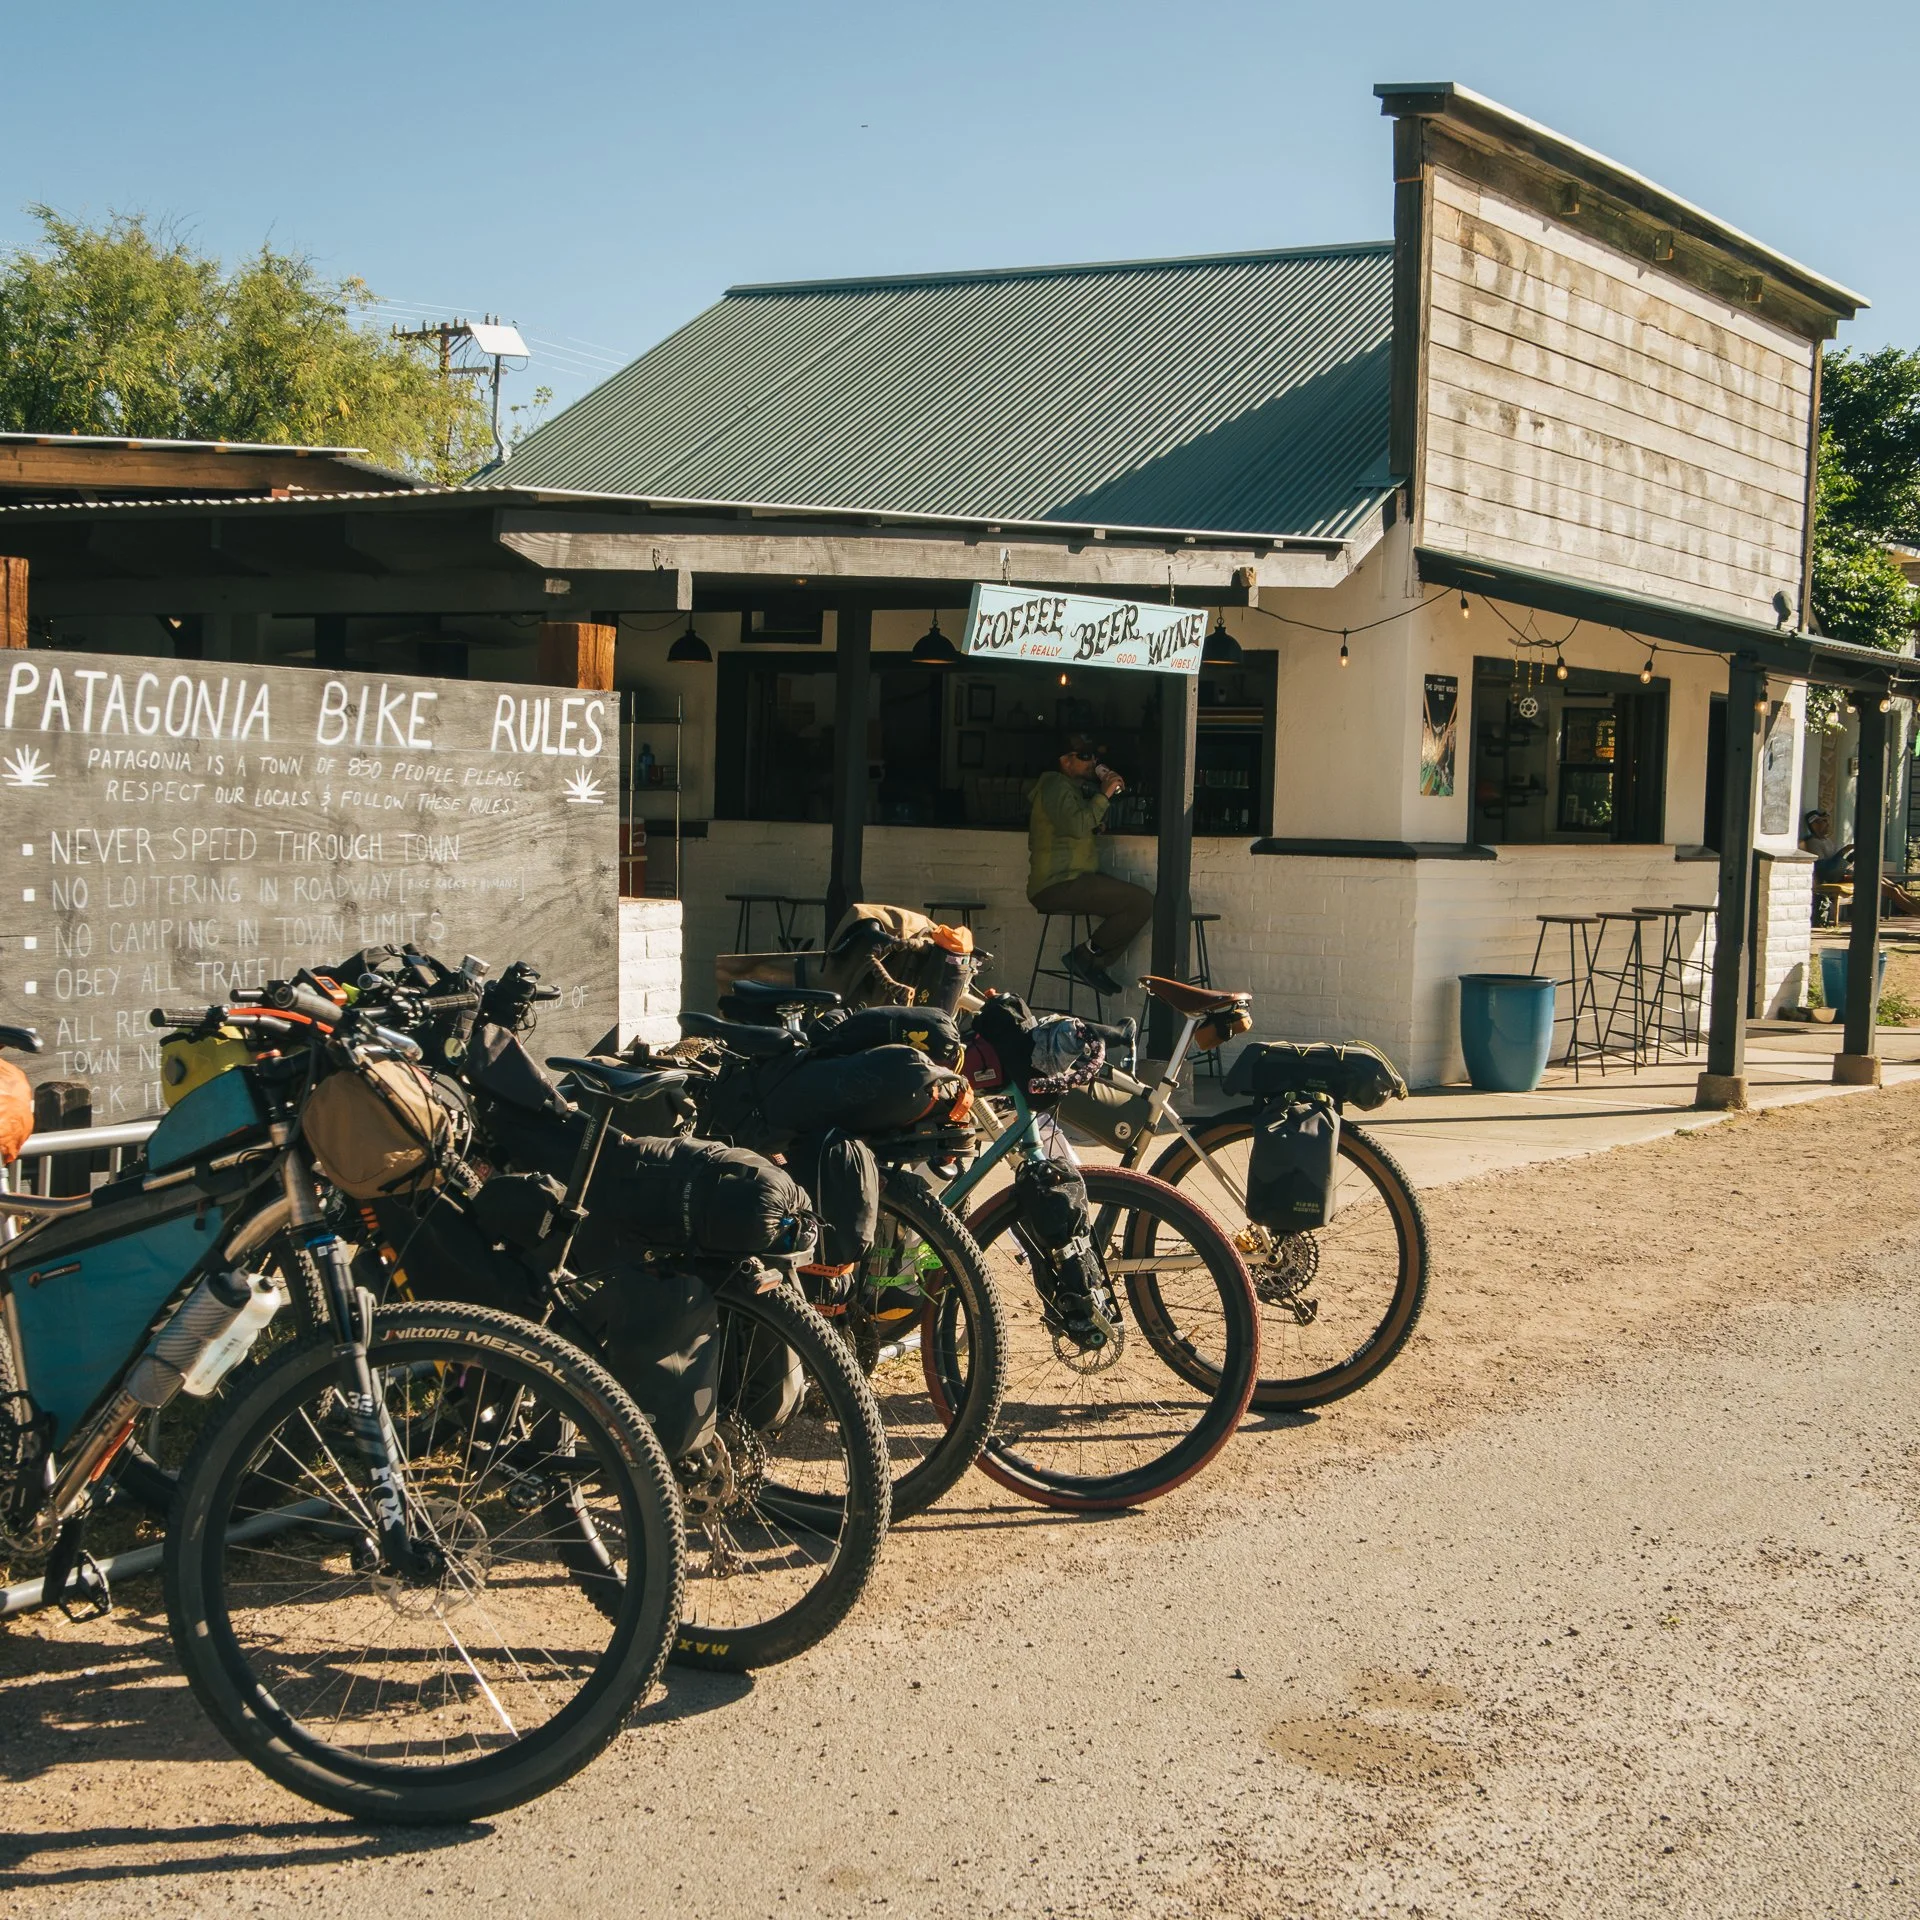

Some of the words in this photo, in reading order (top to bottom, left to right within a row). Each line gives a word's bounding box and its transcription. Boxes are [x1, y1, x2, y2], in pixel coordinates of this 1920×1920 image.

[972, 597, 1068, 651] COFFEE
[1070, 604, 1145, 661] BEER
[1146, 613, 1204, 666] WINE
[1030, 645, 1062, 657] REALLY
[1116, 653, 1137, 664] GOOD
[1170, 655, 1197, 671] VIBES!
[5, 662, 270, 741] PATAGONIA
[316, 681, 438, 748] BIKE
[491, 694, 604, 757] RULES
[87, 748, 192, 773] PATAGONIA
[207, 755, 224, 775] IS
[236, 755, 247, 777] A
[259, 756, 303, 777] TOWN
[316, 757, 337, 775] OF
[347, 757, 382, 780] 850
[463, 767, 525, 788] PLEASE
[106, 780, 206, 803] RESPECT
[215, 787, 245, 804] OUR
[254, 789, 311, 808] LOCALS
[340, 791, 409, 811] FOLLOW
[418, 793, 461, 813] THESE
[51, 827, 156, 864] NEVER
[172, 827, 257, 861] SPEED
[274, 831, 383, 863] THROUGH
[398, 833, 460, 863] TOWN
[52, 877, 89, 911] NO
[107, 875, 242, 908] LOITERING
[259, 877, 279, 903] IN
[294, 870, 393, 903] ROADWAY
[55, 922, 92, 958] NO
[110, 918, 219, 953] CAMPING
[238, 919, 260, 948] IN
[275, 916, 345, 948] TOWN
[360, 912, 446, 945] LIMITS
[55, 967, 121, 1000] OBEY
[140, 962, 181, 994] ALL
[57, 1016, 102, 1047] ALL
[572, 985, 589, 1009] OF
[56, 1045, 120, 1076] TOWN
[138, 1043, 163, 1072] NE
[396, 1327, 460, 1340] vittoria
[464, 1330, 567, 1384] MEZCAL
[347, 1391, 374, 1413] 32
[369, 1463, 406, 1532] FOX
[677, 1638, 730, 1656] MAX
